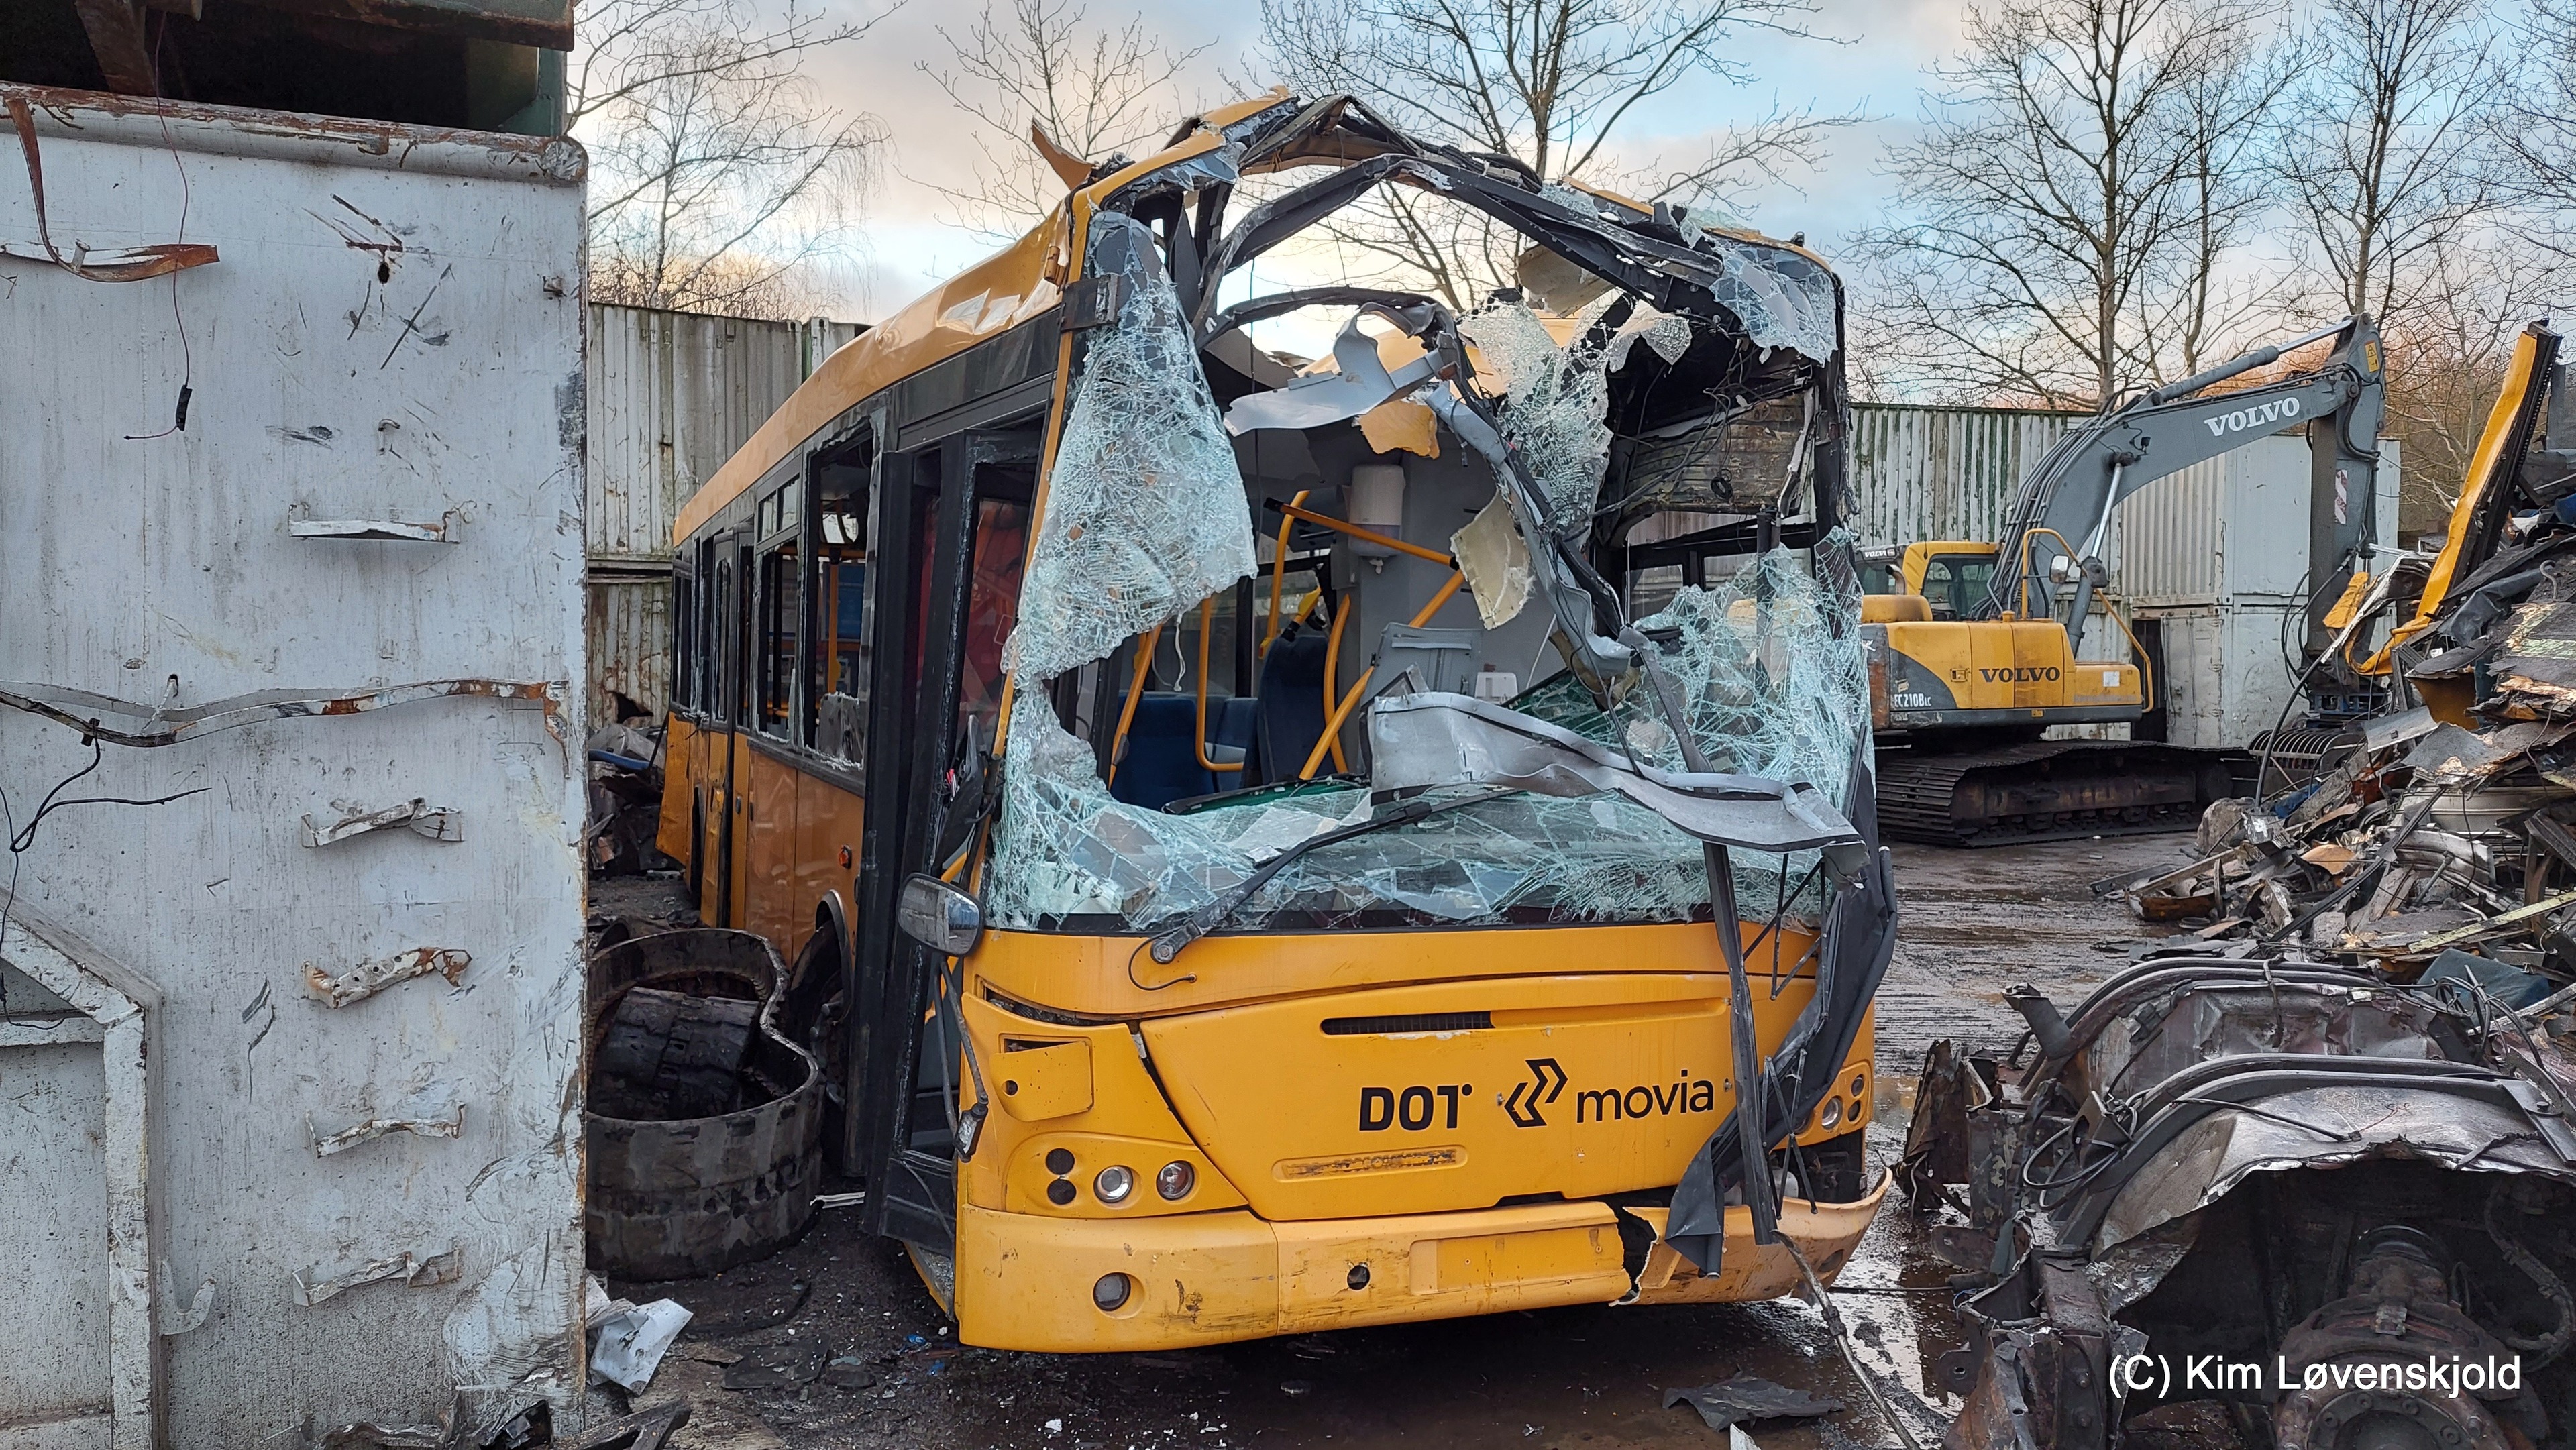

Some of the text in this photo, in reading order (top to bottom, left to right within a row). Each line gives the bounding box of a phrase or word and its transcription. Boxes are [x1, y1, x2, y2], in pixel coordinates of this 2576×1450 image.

[2204, 396, 2300, 437] VOLVO
[1979, 667, 2061, 683] VOLVO
[1358, 1084, 1472, 1131] DOT
[1576, 1069, 1714, 1123] movia
